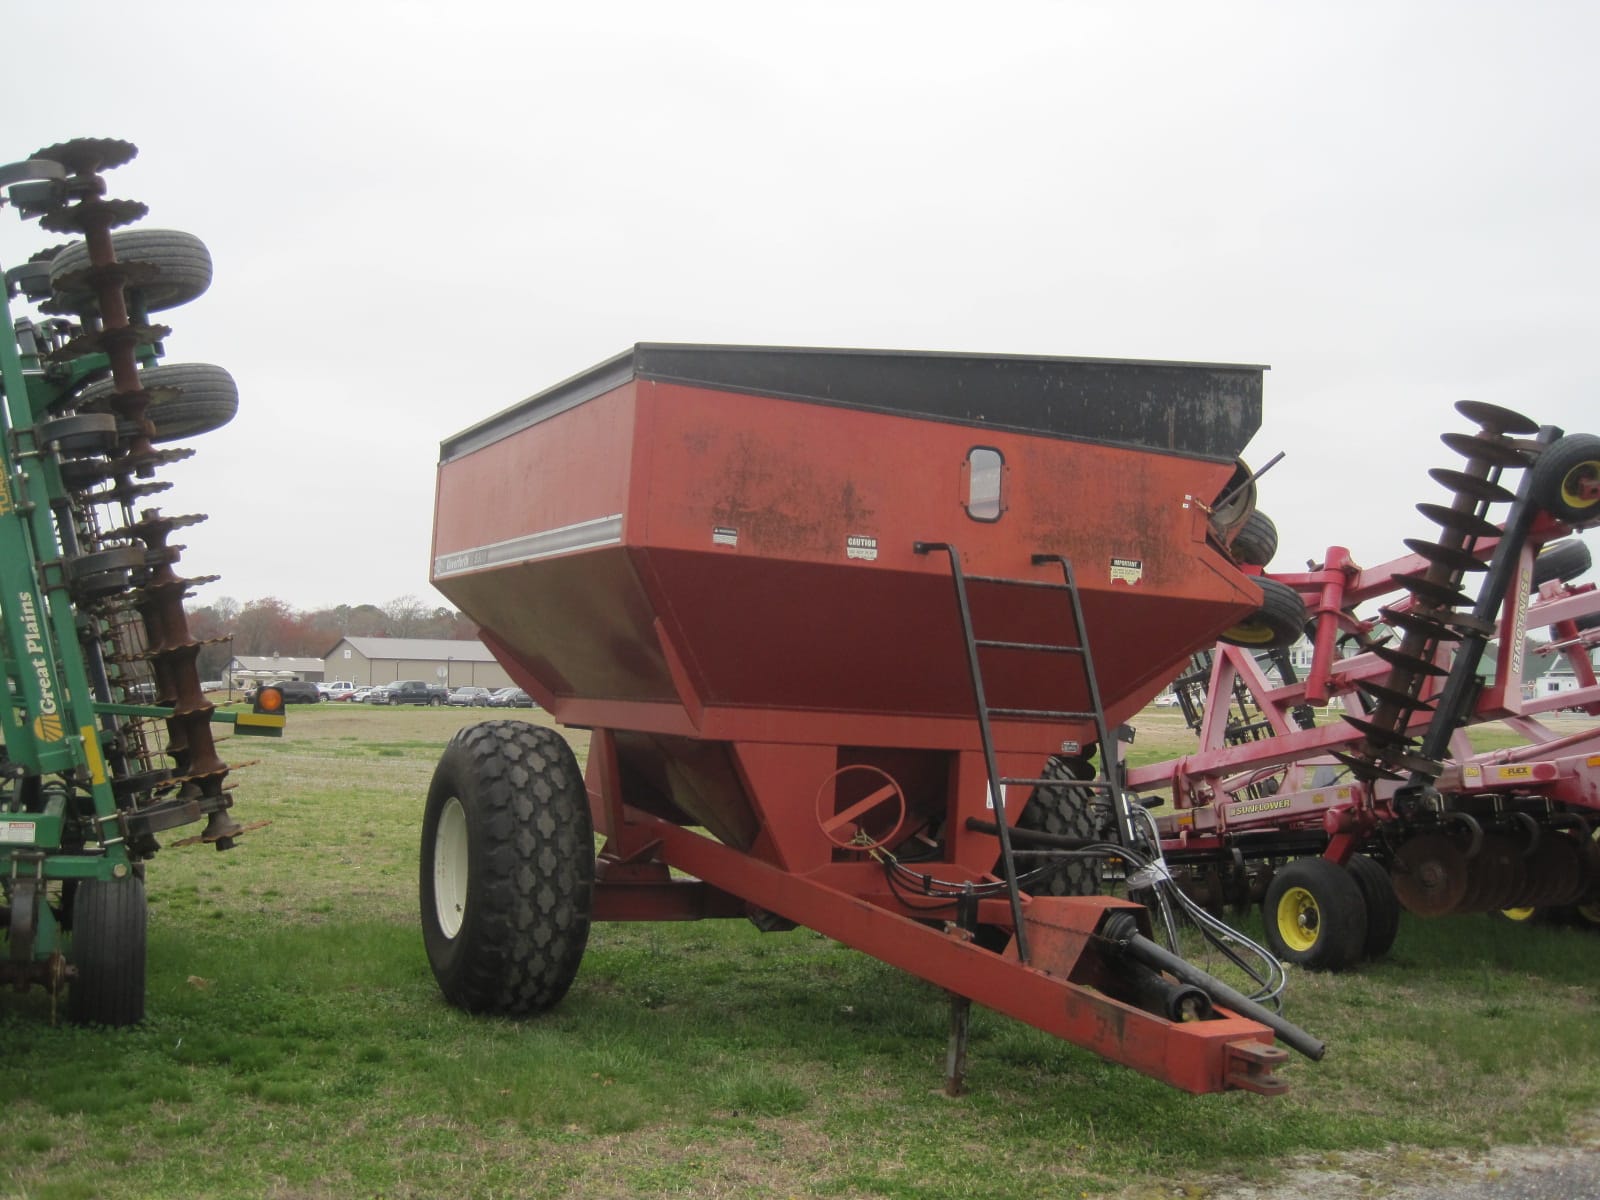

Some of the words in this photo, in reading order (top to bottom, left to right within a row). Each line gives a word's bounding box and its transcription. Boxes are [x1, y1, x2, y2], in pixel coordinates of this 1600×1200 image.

[848, 537, 876, 547] CAUTION
[19, 591, 44, 654] Plains
[1512, 581, 1529, 673] SUNFLOWER
[32, 658, 57, 715] Great
[1508, 767, 1528, 776] FLEX
[1235, 800, 1290, 815] SUNFLOWER
